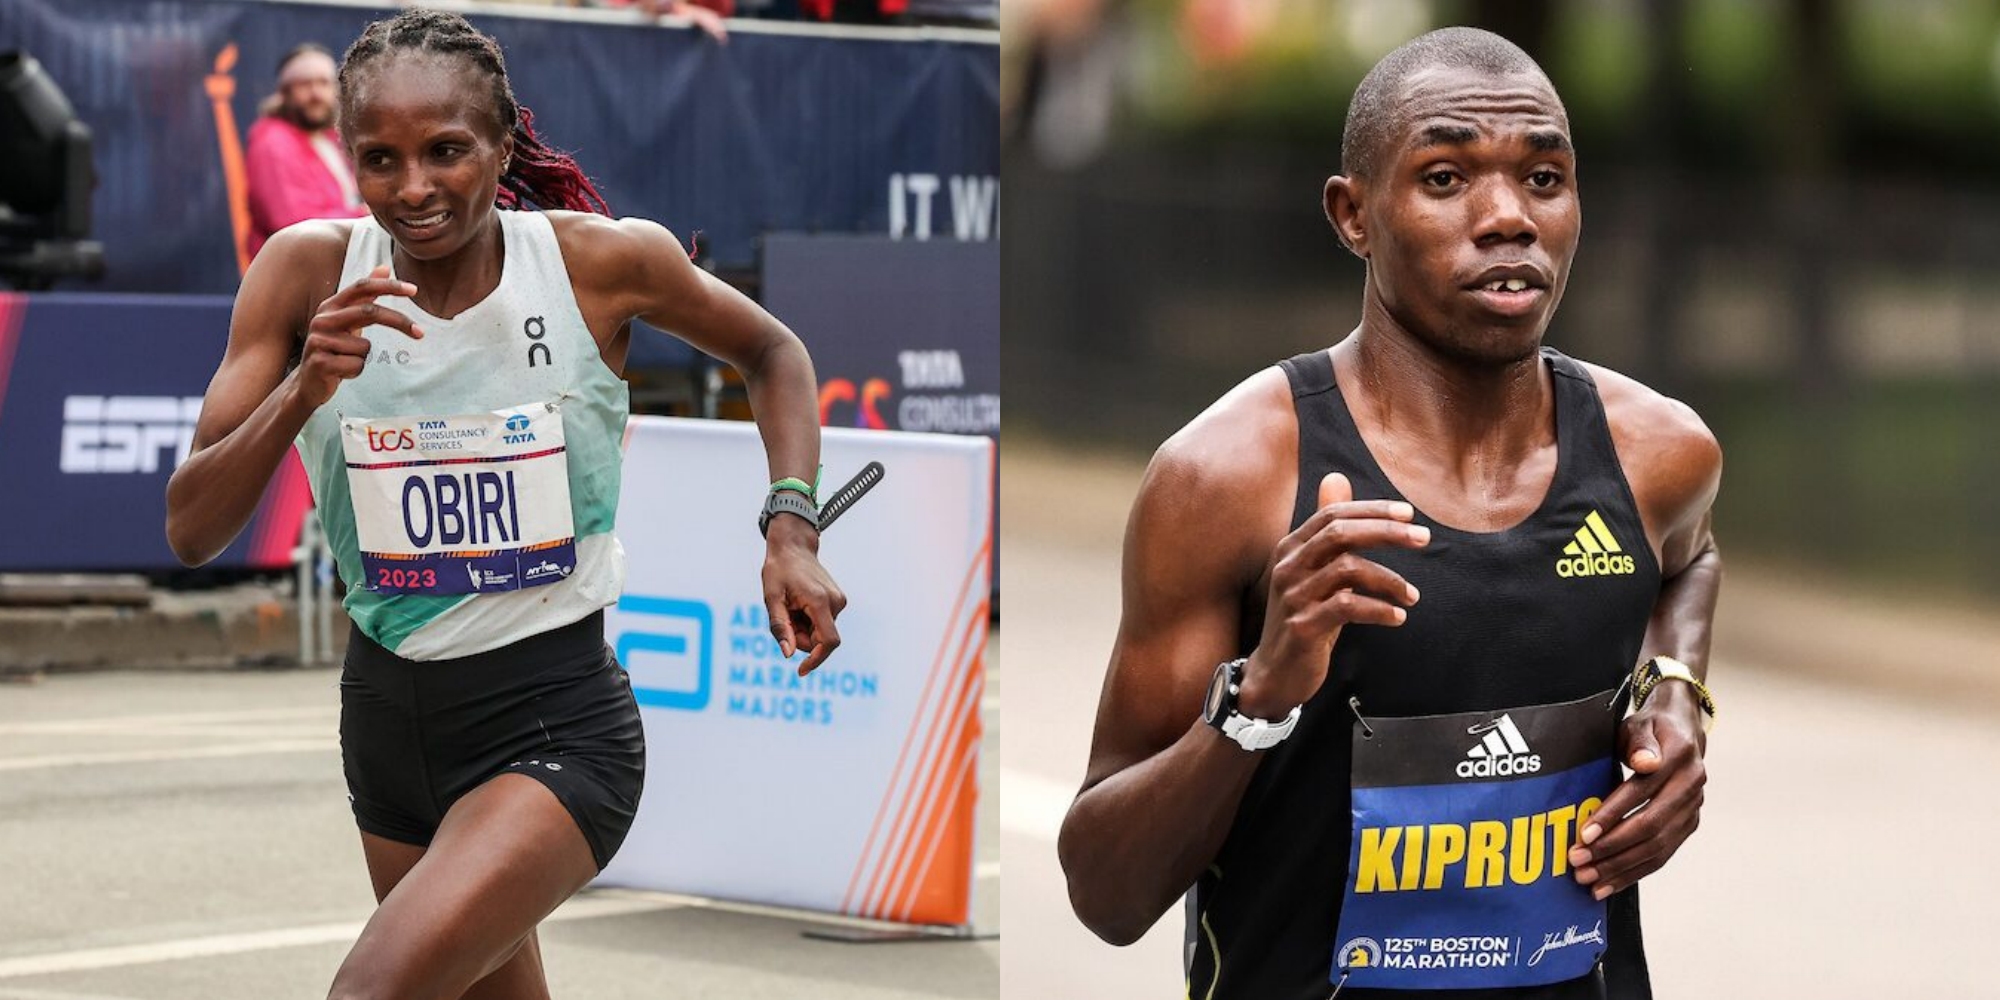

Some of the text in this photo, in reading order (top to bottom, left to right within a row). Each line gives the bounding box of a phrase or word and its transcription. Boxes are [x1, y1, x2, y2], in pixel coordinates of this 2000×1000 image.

[888, 173, 1000, 241] IT W
[417, 420, 447, 430] TATA
[419, 427, 488, 440] CONSULTANCY
[419, 440, 464, 451] SERVICES
[502, 433, 537, 445] TATA
[401, 470, 521, 549] OBIRI
[1556, 551, 1636, 579] adidas
[378, 568, 438, 588] 2023
[728, 664, 879, 697] MARATHON
[727, 692, 834, 726] MAJORS
[1455, 753, 1542, 779] adidas
[1429, 936, 1510, 952] BOSTON
